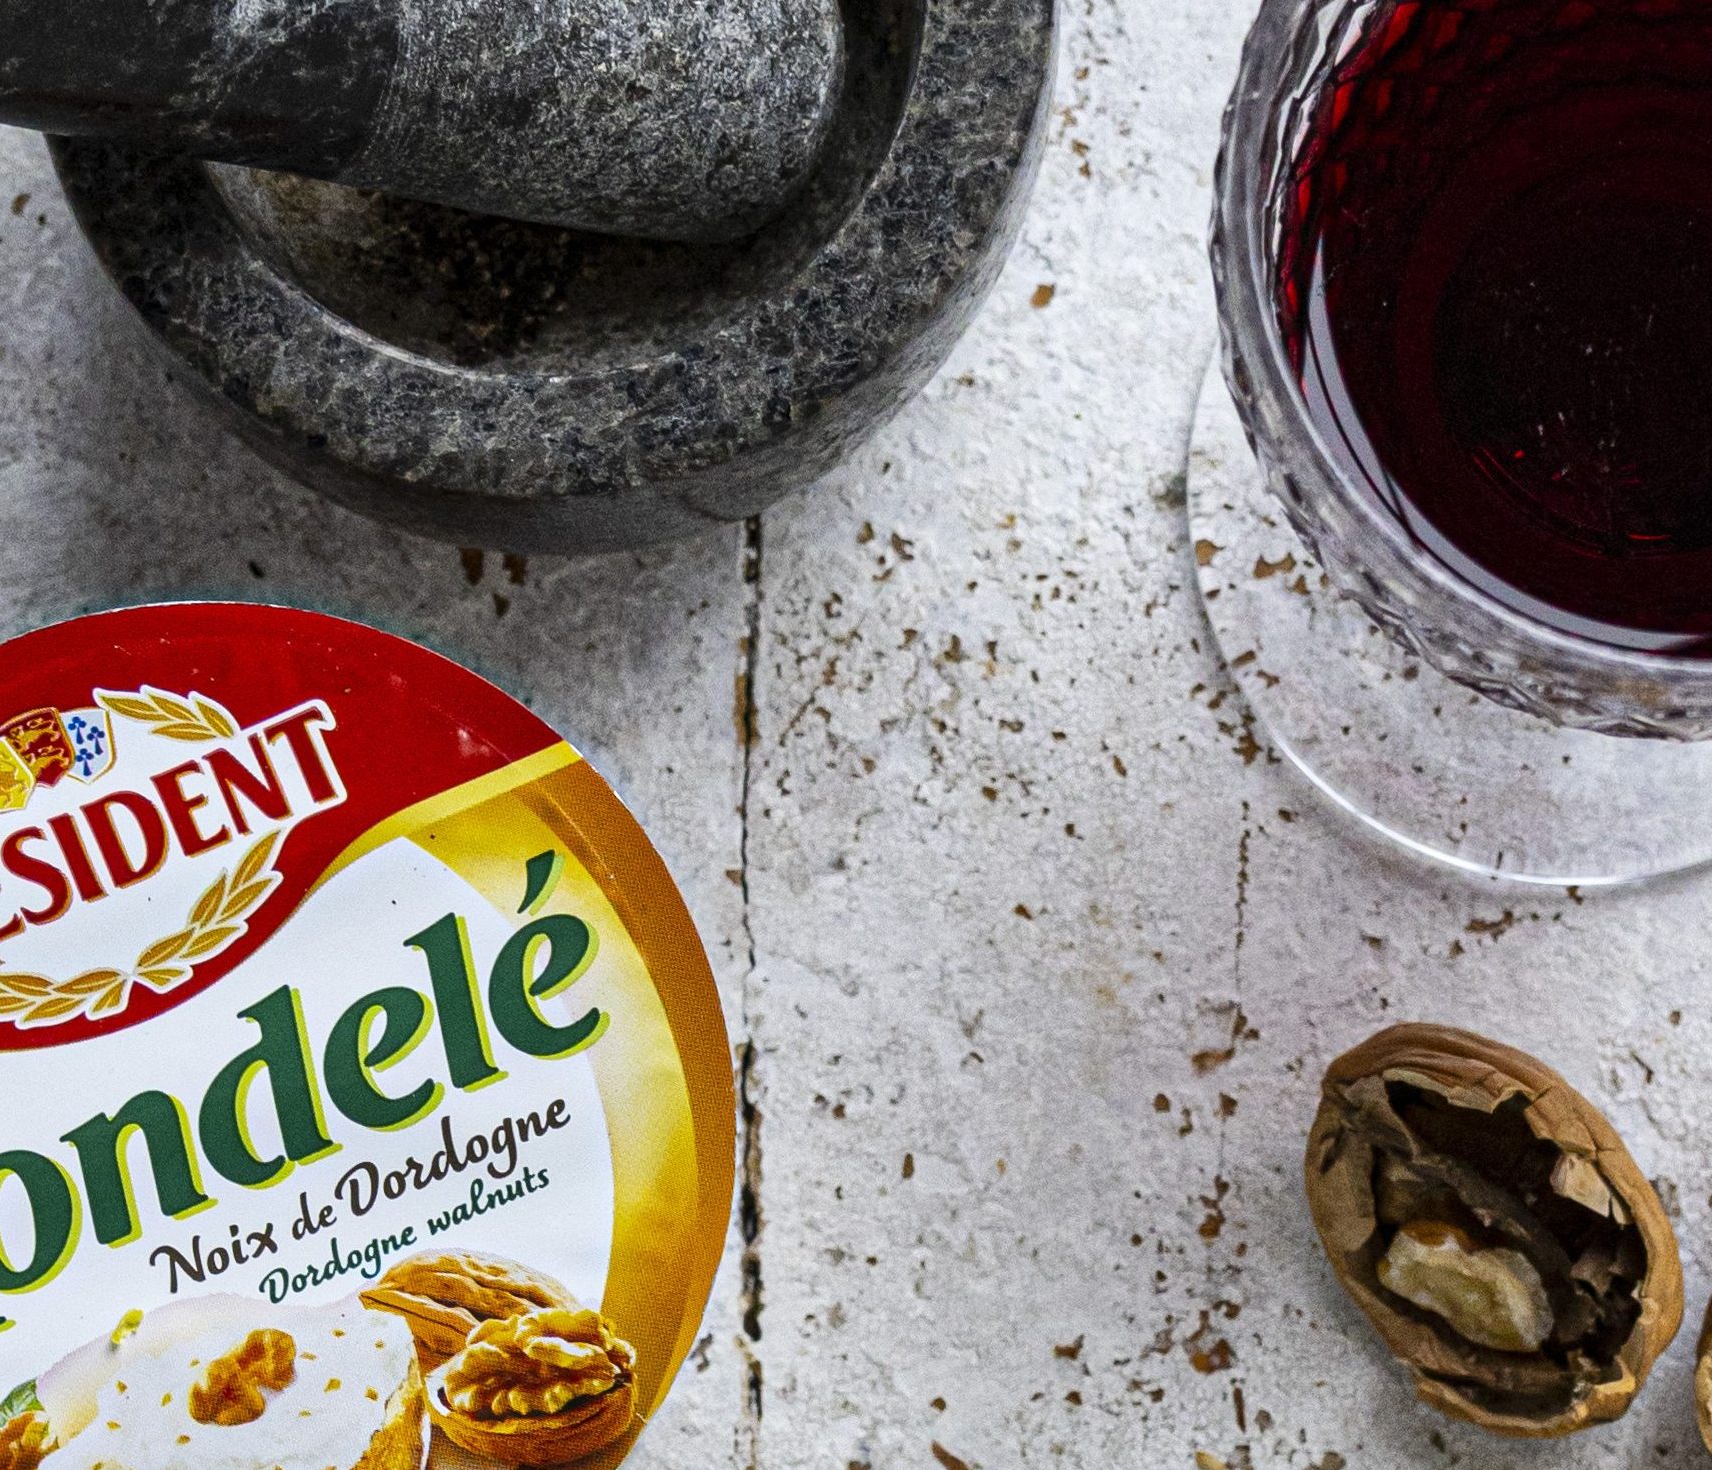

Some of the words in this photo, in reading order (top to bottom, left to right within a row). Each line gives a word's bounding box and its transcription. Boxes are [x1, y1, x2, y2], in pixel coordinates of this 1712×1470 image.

[149, 1223, 278, 1294] Noix
[292, 1192, 338, 1241] de
[335, 1098, 571, 1217] Dordogne
[259, 1225, 418, 1304] Dordogne
[427, 1167, 550, 1234] walnuts
